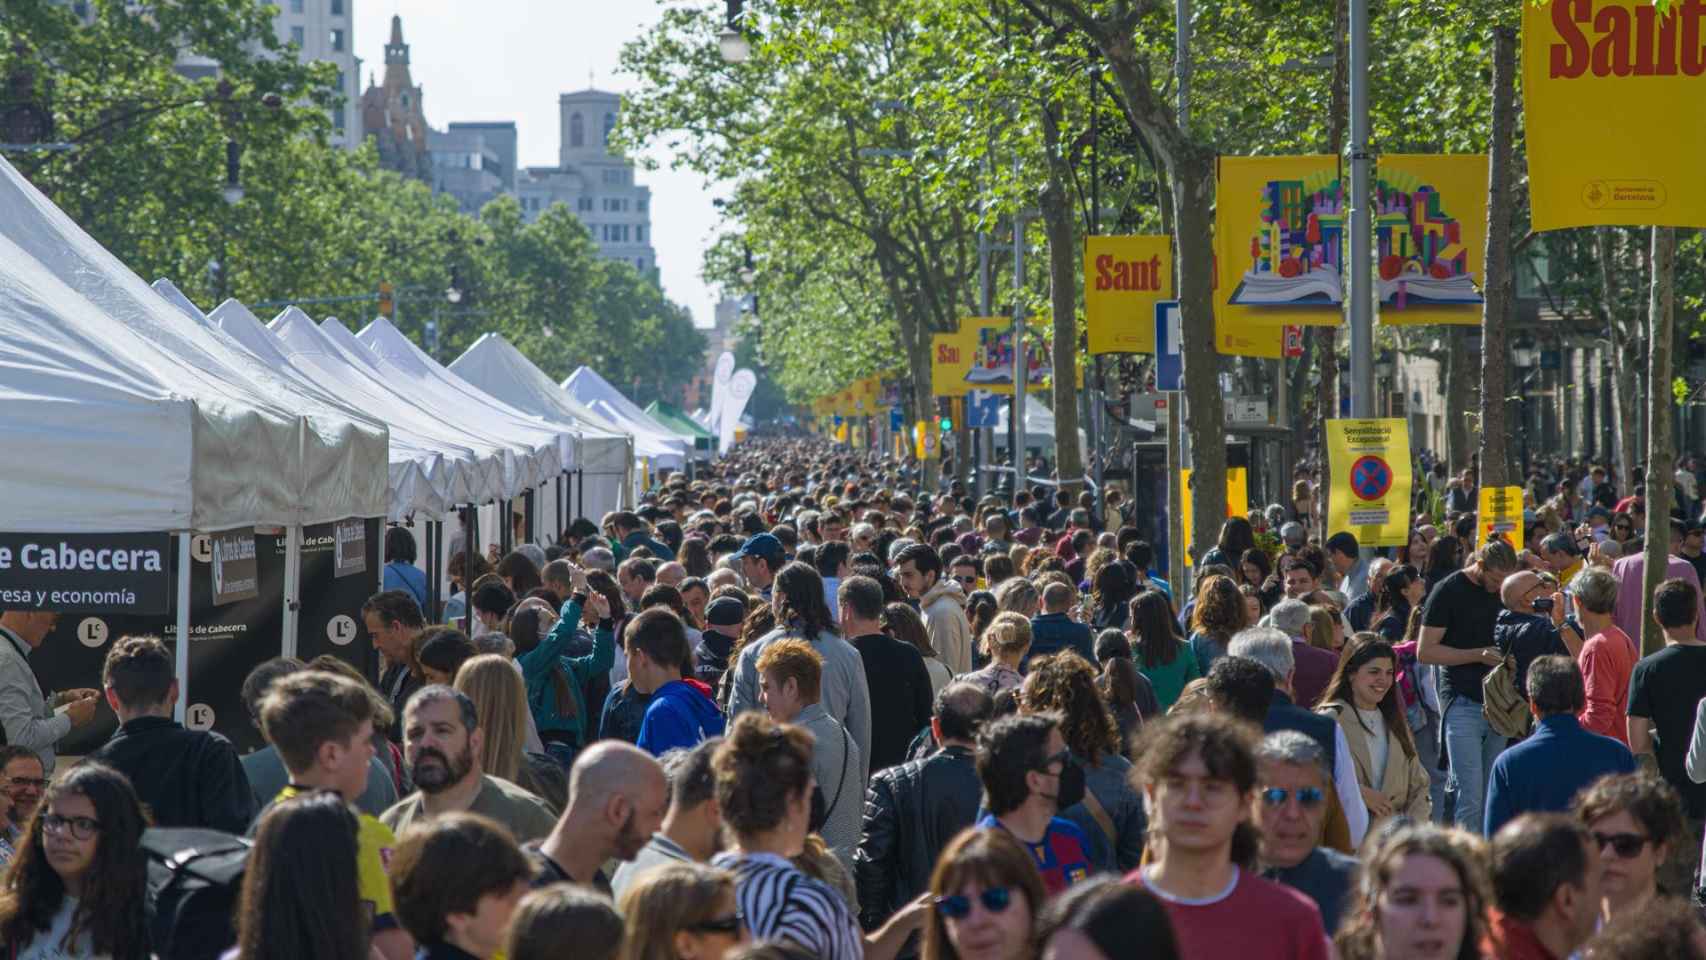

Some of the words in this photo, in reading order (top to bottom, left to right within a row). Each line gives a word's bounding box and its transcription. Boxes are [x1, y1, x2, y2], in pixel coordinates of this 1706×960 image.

[1550, 0, 1706, 79] Sant
[1095, 254, 1161, 291] Sant
[20, 542, 162, 571] Cabecera
[35, 591, 46, 607] y
[50, 588, 136, 604] economía
